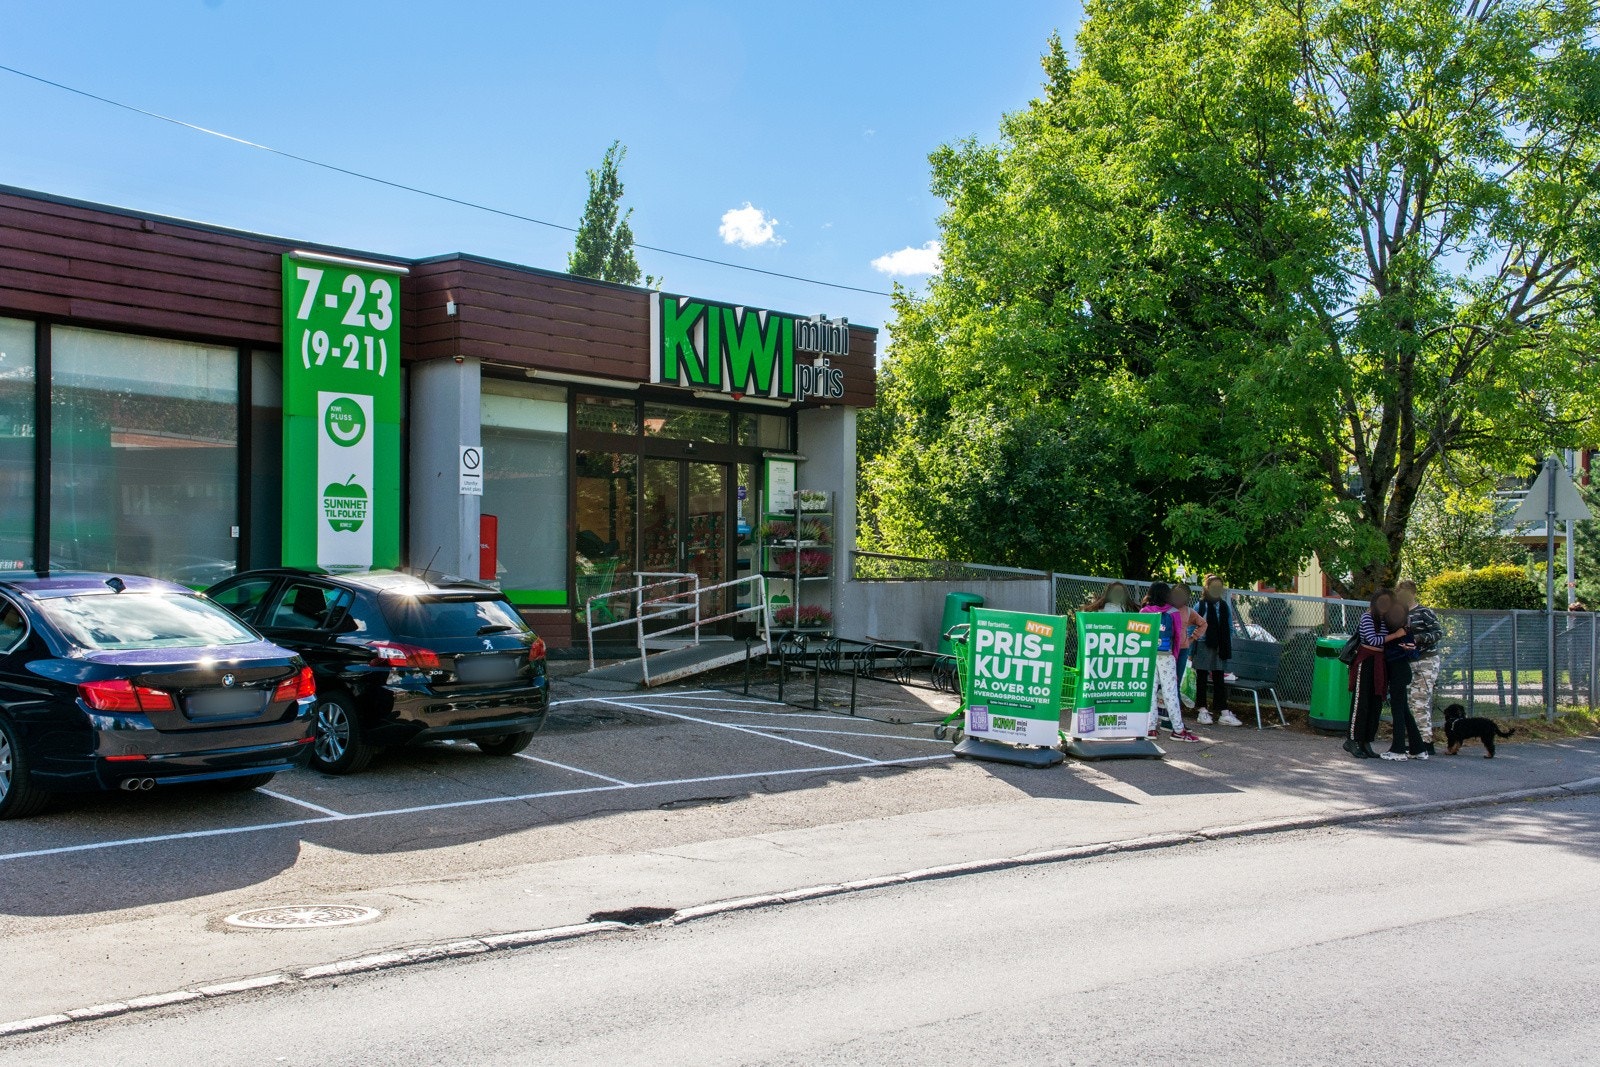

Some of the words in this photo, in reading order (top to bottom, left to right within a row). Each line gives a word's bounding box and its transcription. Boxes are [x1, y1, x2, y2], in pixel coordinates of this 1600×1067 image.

[297, 266, 393, 331] 7-23
[797, 313, 849, 356] mini
[302, 328, 387, 377] (9-21)
[660, 294, 796, 398] KIWI
[797, 358, 844, 402] pris
[330, 413, 353, 421] PLUSS
[323, 499, 368, 509] SUNNHET
[338, 510, 367, 518] FOLKET
[1026, 622, 1052, 636] NYTT
[1128, 622, 1150, 633] NYTT
[976, 629, 1054, 659] PRIS-
[1085, 633, 1151, 655] PRIS-
[974, 654, 1052, 684] KUTT!
[1084, 657, 1149, 679] KUTT!
[974, 678, 988, 689] PÅ
[991, 681, 1024, 694] OVER
[1027, 686, 1050, 697] 100
[1083, 681, 1095, 691] PÅ
[1097, 681, 1124, 690] OVER
[1128, 681, 1147, 690] 100
[973, 690, 1050, 704] HVERDAGSPRODUKTER!
[993, 717, 1016, 730] KIWI
